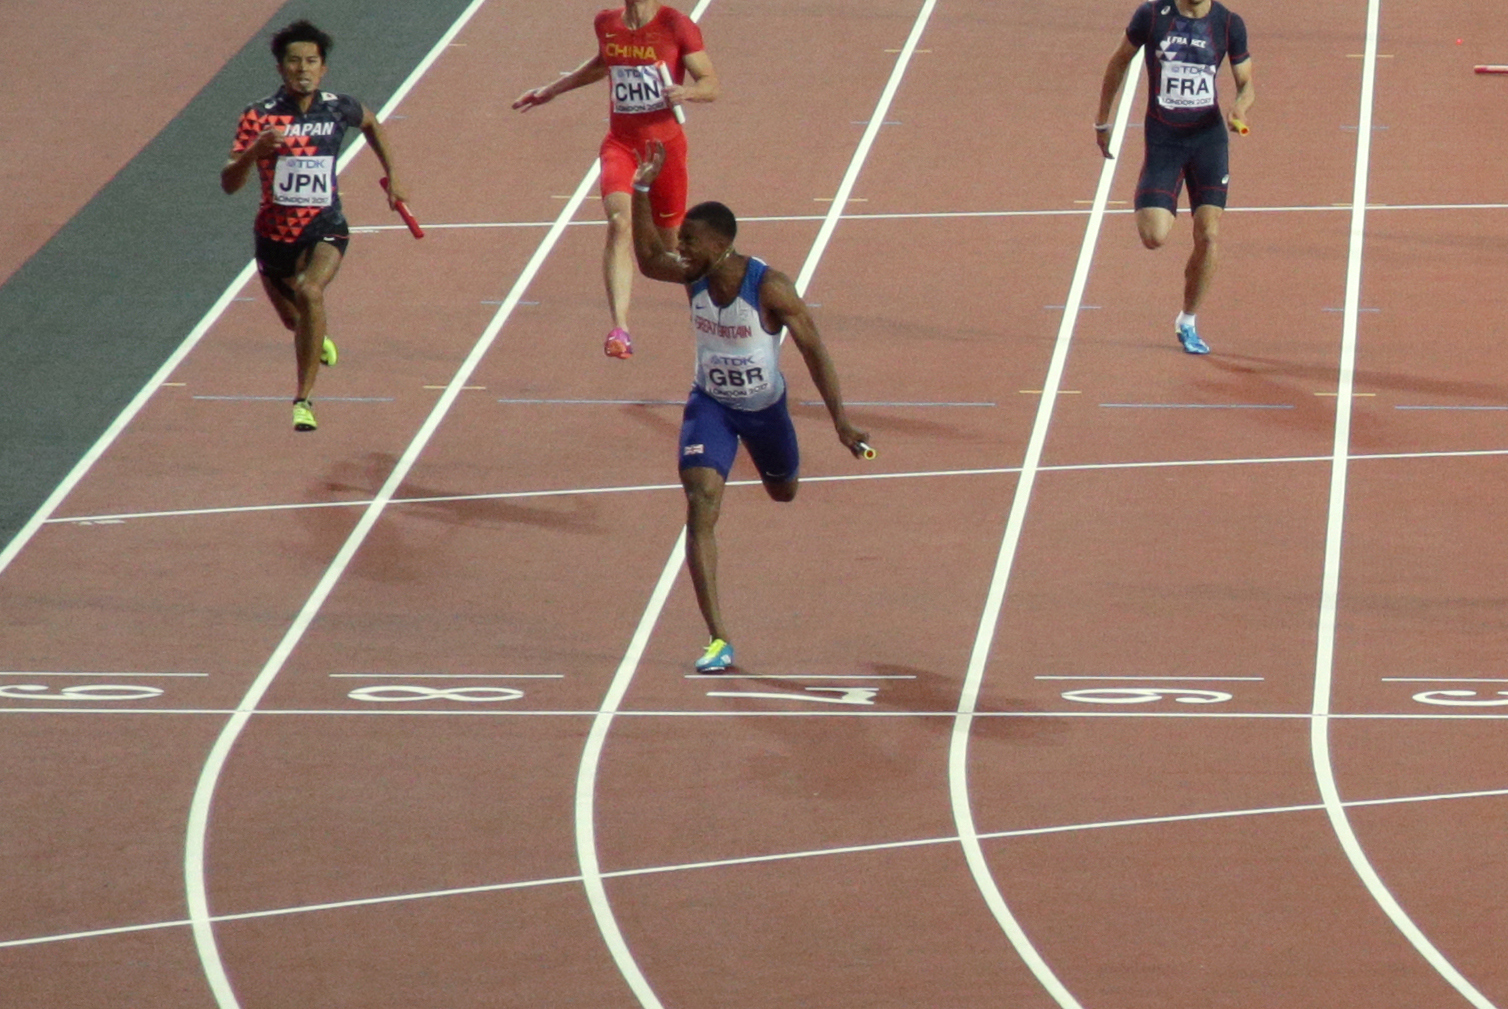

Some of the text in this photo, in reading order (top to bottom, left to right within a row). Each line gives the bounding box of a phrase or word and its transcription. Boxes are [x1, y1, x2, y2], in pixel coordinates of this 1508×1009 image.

[606, 43, 657, 60] CHINA
[615, 80, 660, 101] CHN
[1166, 77, 1209, 96] FRA
[284, 122, 334, 136] JAPAN
[297, 159, 325, 168] TDK
[279, 173, 327, 193] JPN
[720, 356, 755, 366] TDK
[709, 367, 764, 386] GBR
[348, 686, 525, 702] 8
[706, 687, 880, 705] 7
